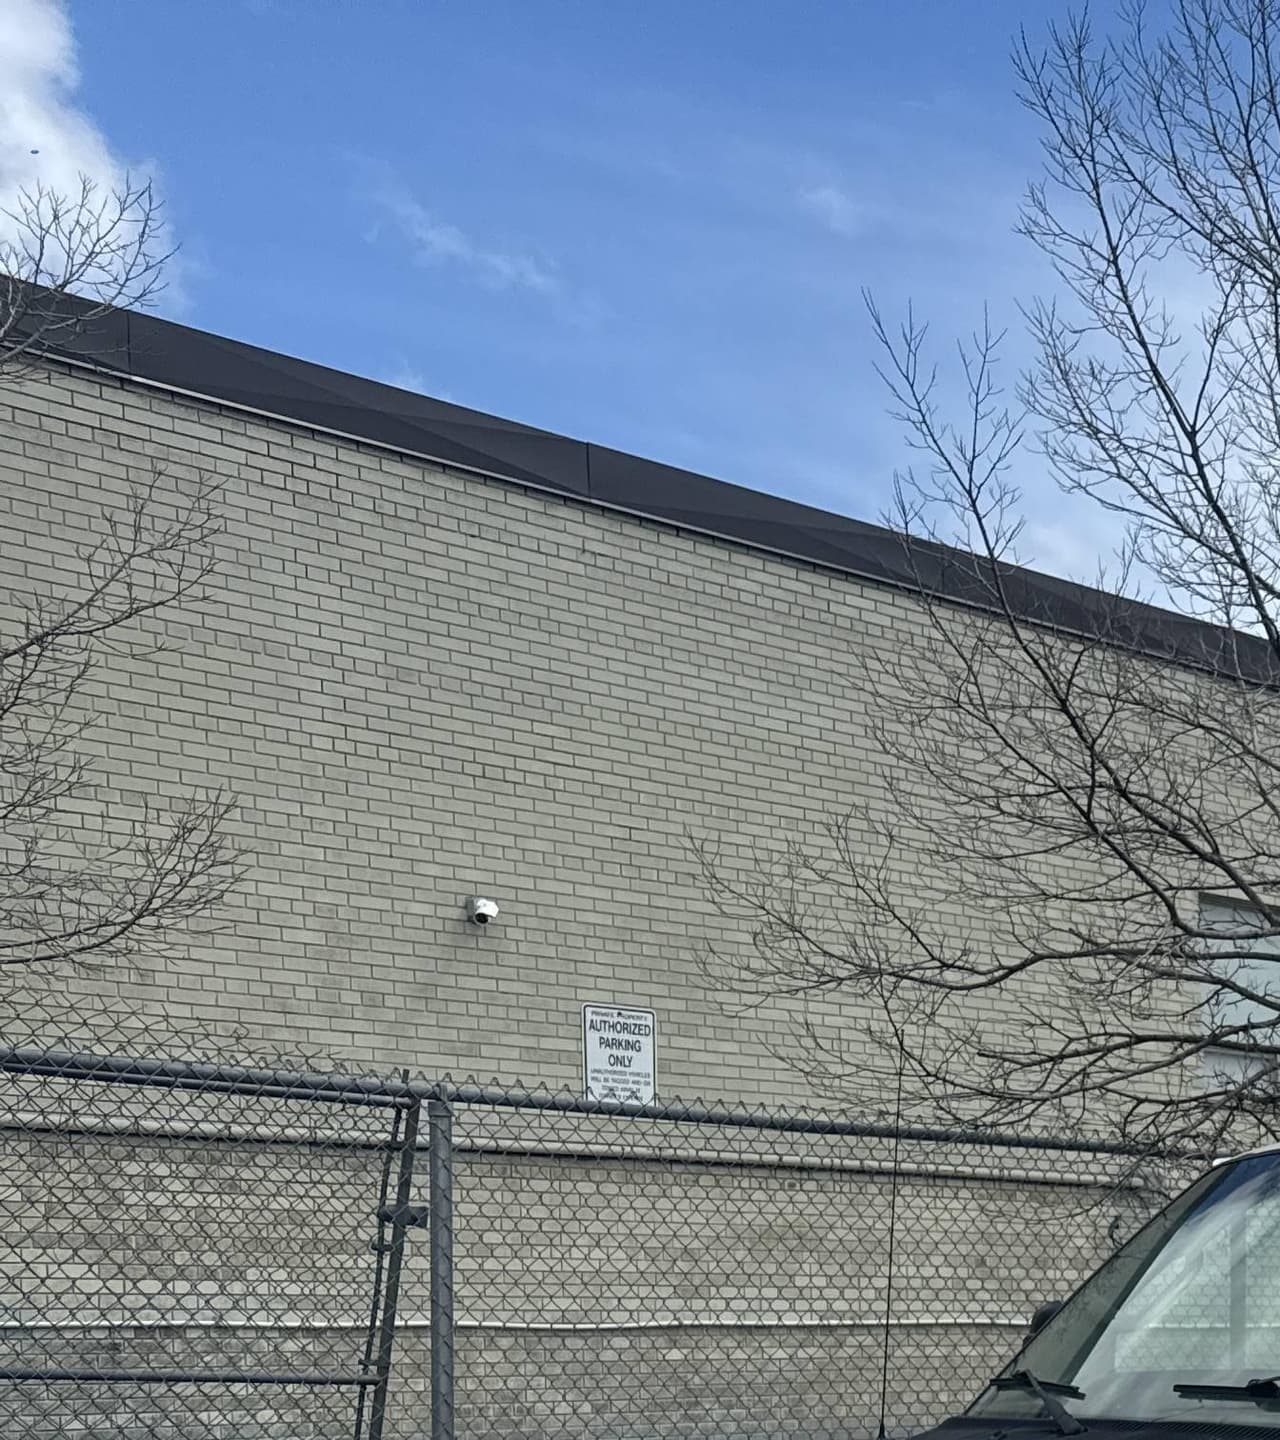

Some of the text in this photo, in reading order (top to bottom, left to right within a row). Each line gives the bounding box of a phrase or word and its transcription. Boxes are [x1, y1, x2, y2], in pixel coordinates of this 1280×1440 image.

[589, 1019, 651, 1036] AUTHORIZED
[599, 1036, 642, 1052] PARKING
[608, 1054, 633, 1067] ONLY
